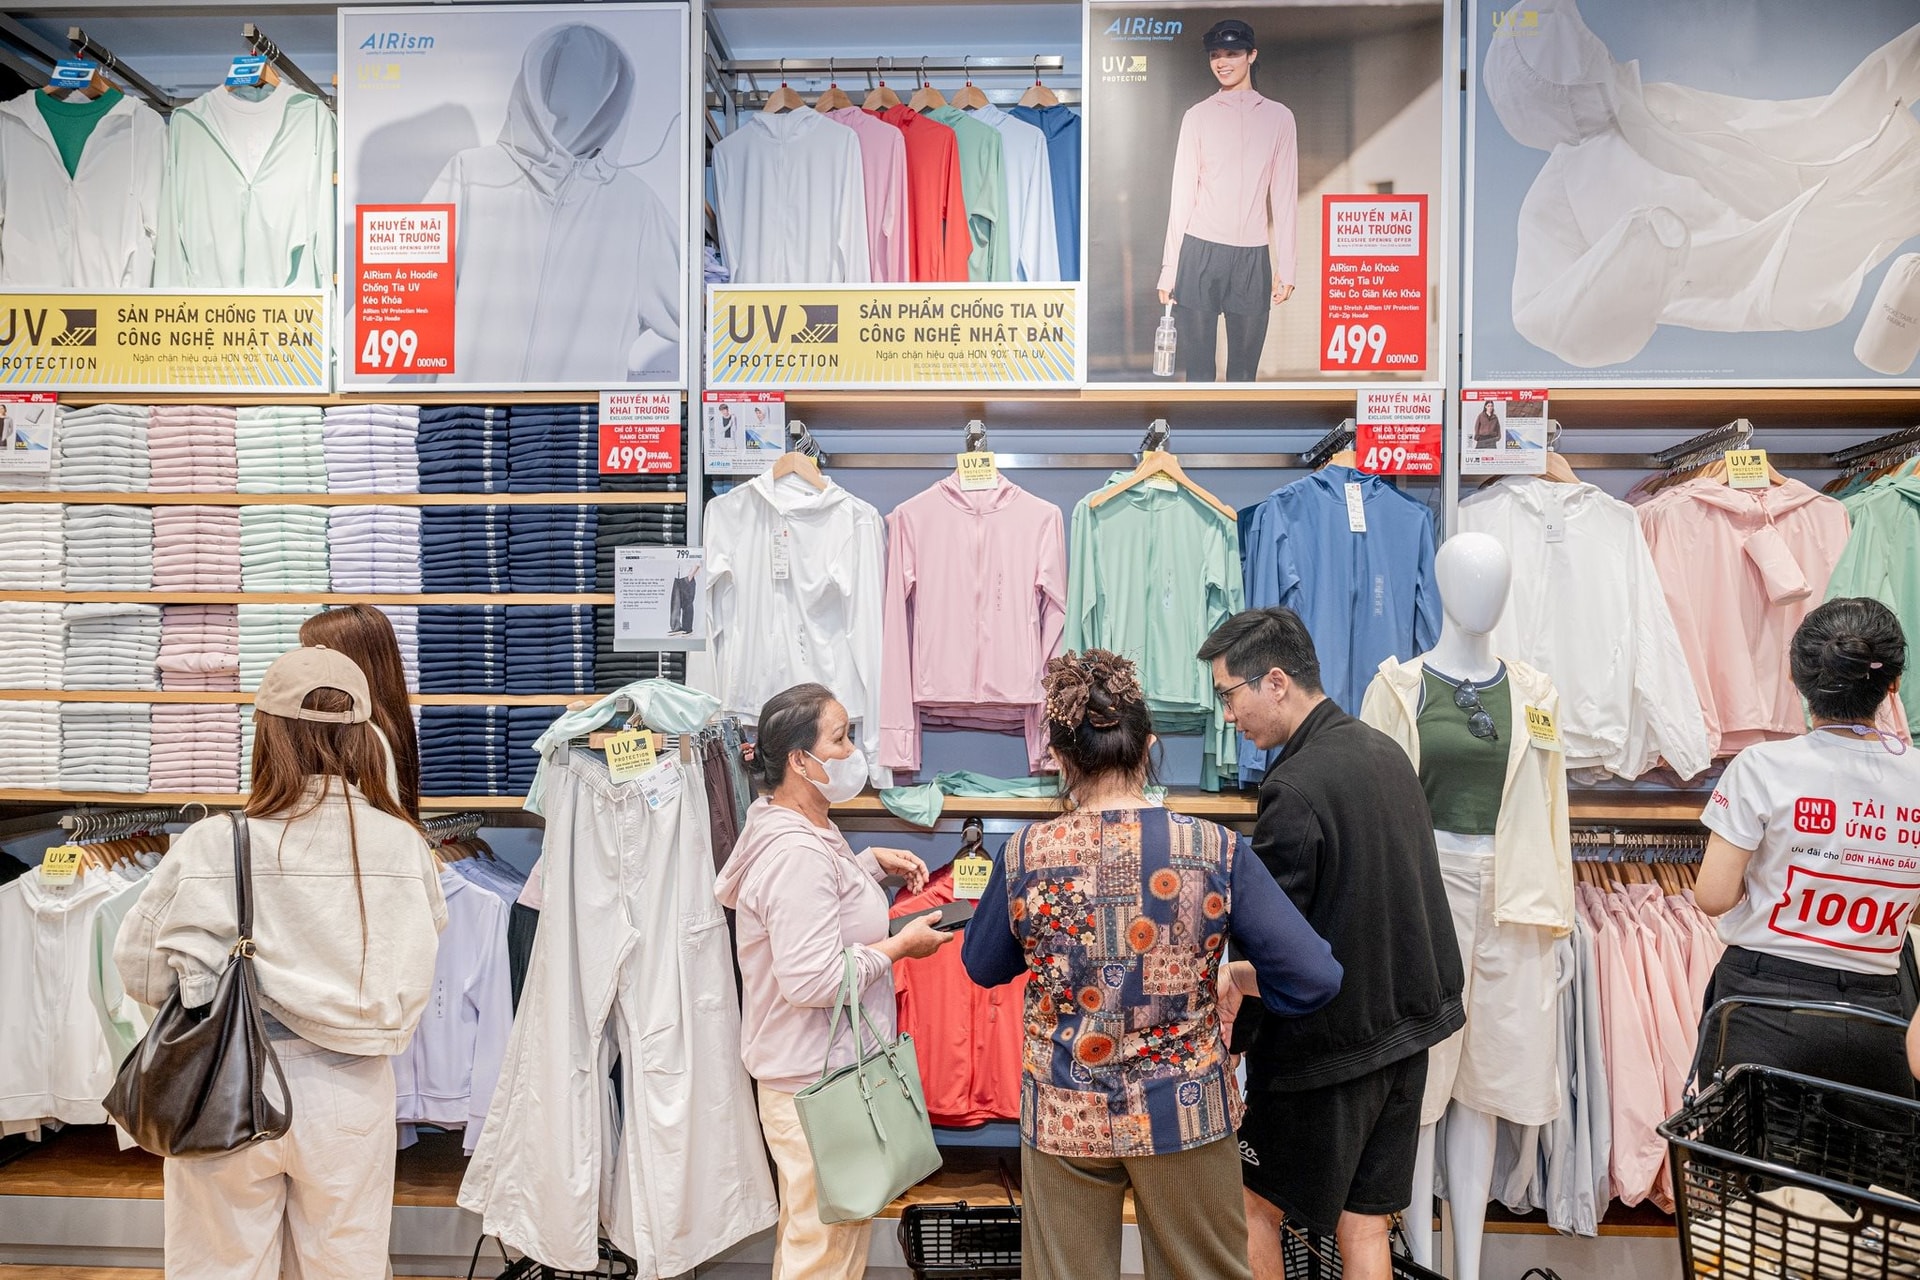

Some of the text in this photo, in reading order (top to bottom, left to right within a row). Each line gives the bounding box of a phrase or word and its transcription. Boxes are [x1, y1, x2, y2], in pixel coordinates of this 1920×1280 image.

[1104, 17, 1183, 35] AIRism
[360, 33, 435, 49] AIRism
[1102, 56, 1126, 72] UV
[1337, 208, 1385, 222] KHUYẾN
[370, 217, 415, 230] KHUYẾN
[1337, 224, 1412, 234] KHAI TRƯƠNG
[370, 233, 440, 242] KHAI TRƯƠNG
[1329, 263, 1357, 272] AIRism
[363, 271, 392, 279] AIRism
[410, 270, 438, 279] Hoodie
[1357, 276, 1370, 285] Tia
[1372, 276, 1384, 285] UV
[392, 283, 405, 291] Tia
[408, 283, 420, 291] UV
[1348, 289, 1359, 298] Co
[118, 302, 314, 323] SẢN PHẨM CHỐNG TIA UV
[859, 297, 1064, 319] SẢN PHẨM CHỐNG TIA UV
[0, 309, 47, 346] UV
[728, 305, 787, 343] UV
[117, 327, 313, 350] CÔNG NGHỆ NHẬT BẢN
[859, 323, 1063, 345] CÔNG NGHỆ NHẬT BẢN
[362, 329, 418, 367] 499
[1327, 324, 1387, 363] 499
[265, 354, 279, 362] TIA
[729, 354, 838, 367] PROTECTION
[968, 350, 987, 359] HƠN
[1013, 350, 1028, 358] TIA
[2, 357, 96, 369] ROTECTION
[610, 393, 648, 404] KHUYẾN
[758, 393, 770, 401] 499
[1368, 392, 1408, 402] KHUYẾN
[1520, 391, 1532, 400] 599
[635, 406, 669, 414] TRƯƠNG
[1394, 405, 1431, 413] TRƯƠNG
[607, 446, 647, 469] 499
[963, 459, 977, 468] UV
[1364, 446, 1407, 470] 499
[1731, 456, 1747, 466] UV
[676, 550, 689, 558] 799
[1529, 712, 1540, 724] UV
[611, 741, 630, 755] UV
[614, 753, 649, 762] PROTECTION
[1799, 801, 1829, 816] UNI
[1852, 799, 1884, 819] TẢI
[1798, 815, 1831, 830] QLO
[1846, 819, 1886, 841] ỨNG
[49, 853, 66, 863] UV
[1823, 851, 1839, 860] cho
[1845, 853, 1864, 863] ĐƠN
[1868, 854, 1894, 867] HÀNG
[960, 865, 974, 875] UV
[1798, 888, 1910, 937] 100K
